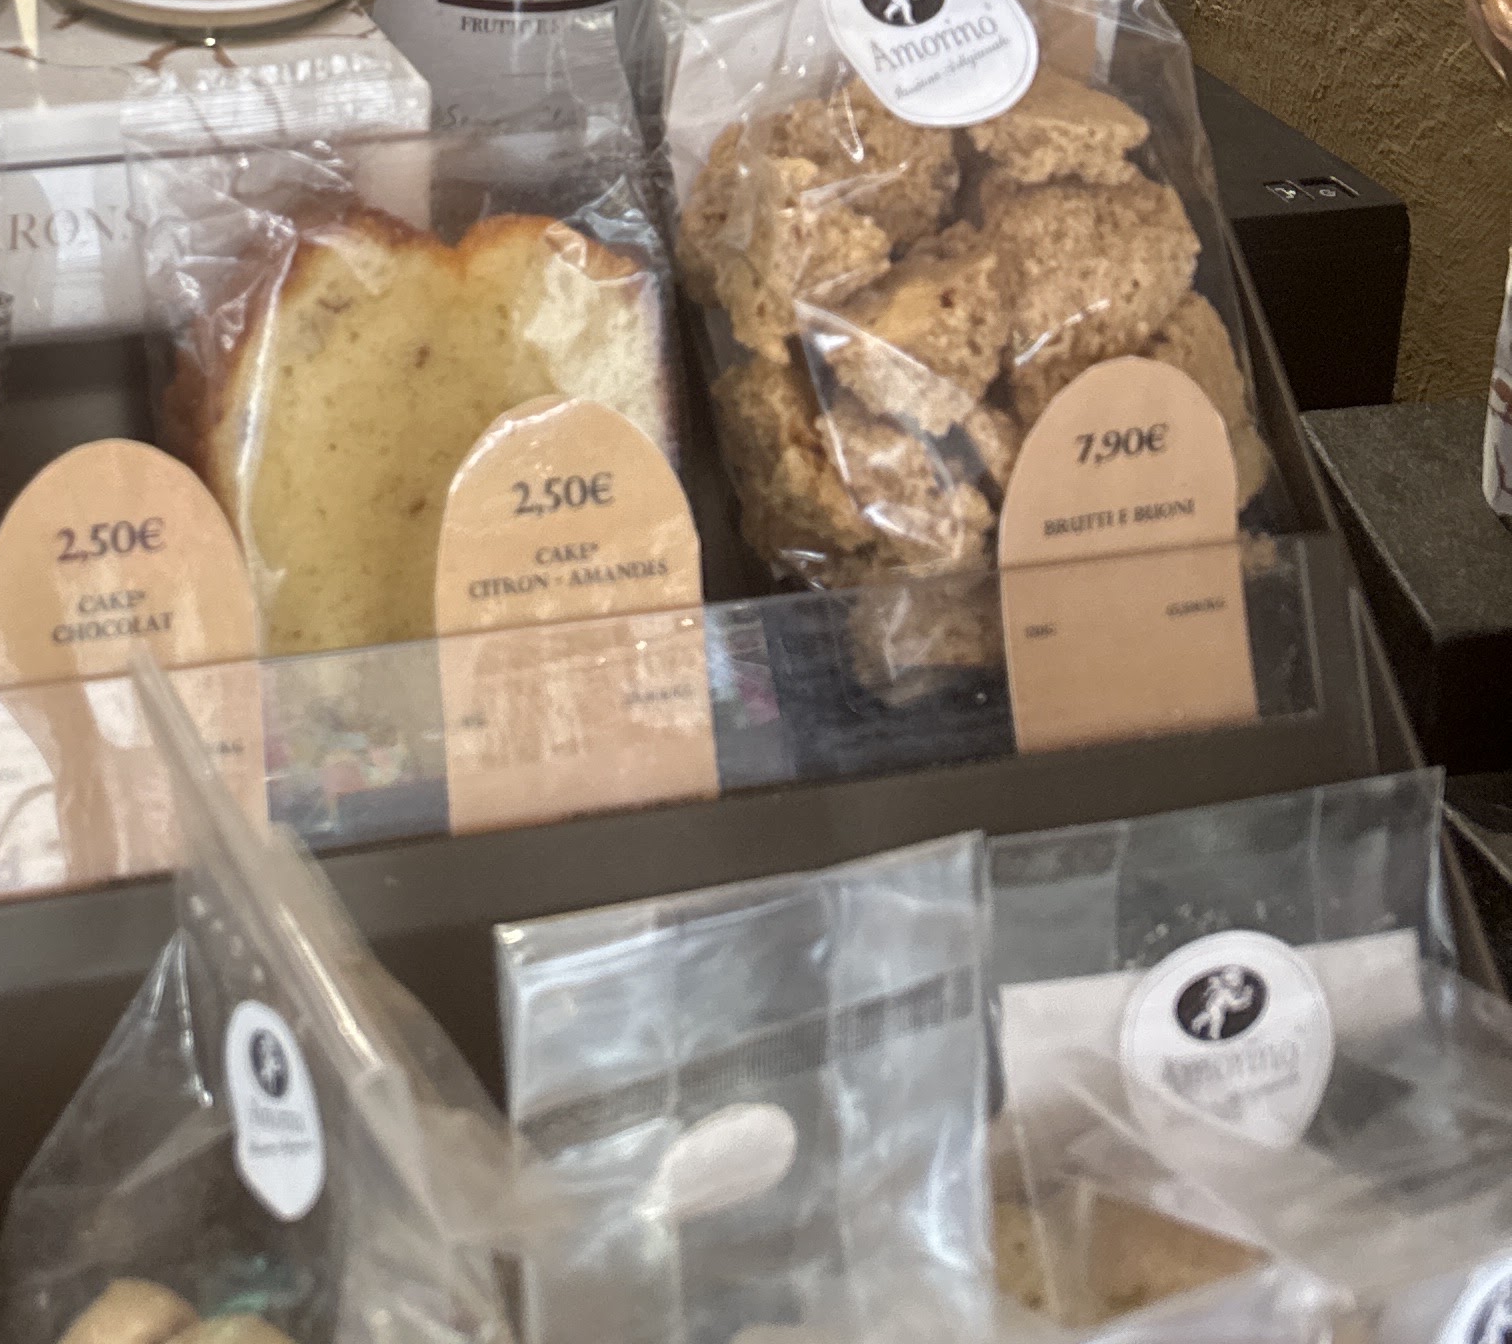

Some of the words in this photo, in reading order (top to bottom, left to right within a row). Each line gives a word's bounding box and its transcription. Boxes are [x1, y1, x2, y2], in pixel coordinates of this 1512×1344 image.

[870, 16, 999, 73] Amorino
[1075, 422, 1170, 467] 7,90€
[512, 471, 615, 517] 2,50€
[57, 515, 167, 562] 2,50€
[1044, 511, 1113, 537] BRUTTI
[1134, 497, 1195, 523] BUONI
[468, 573, 549, 600] CITRON
[568, 558, 669, 586] AMANDES
[52, 612, 173, 646] CHOCOLAT
